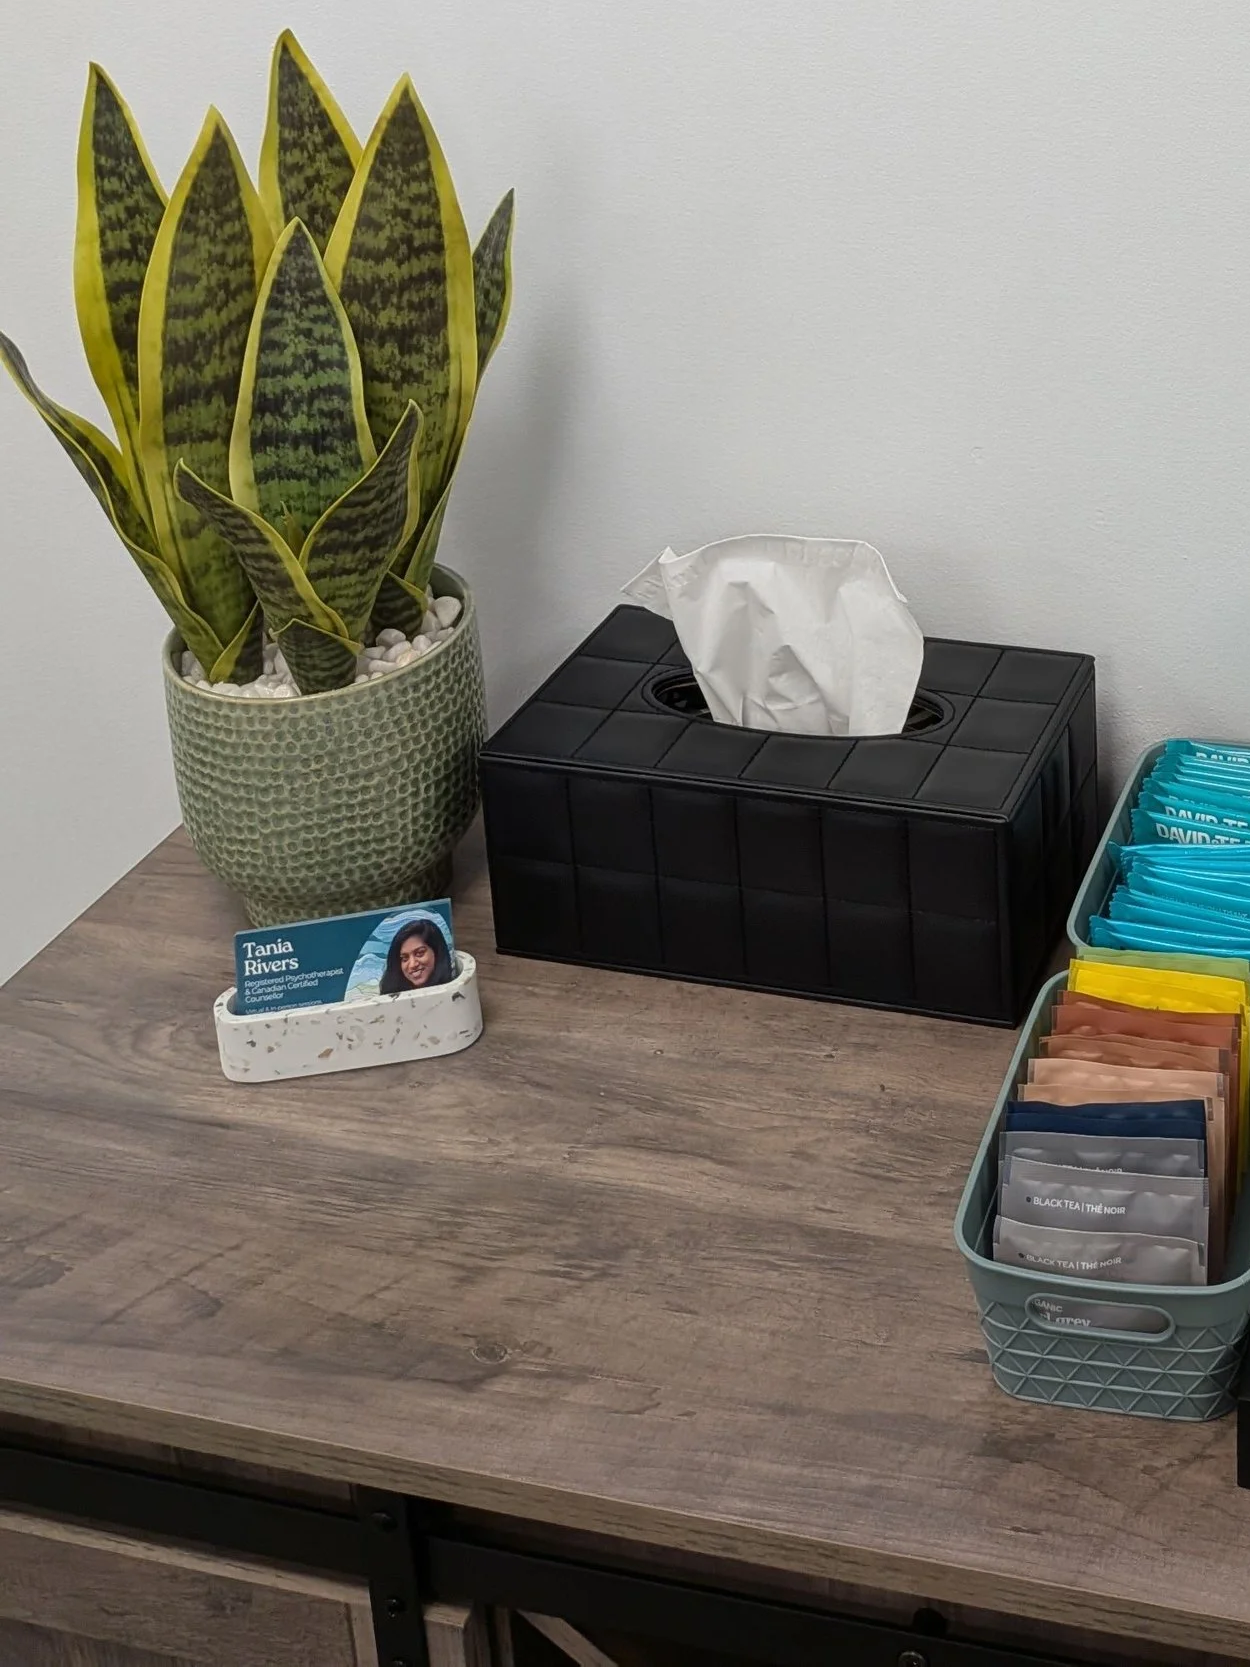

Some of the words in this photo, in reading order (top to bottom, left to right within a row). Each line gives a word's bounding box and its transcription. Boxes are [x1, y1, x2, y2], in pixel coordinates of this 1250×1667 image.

[243, 938, 293, 958] Tania
[244, 958, 299, 976] Rivers
[244, 977, 284, 988] Registered
[285, 968, 344, 982] Psychotherapist
[252, 985, 286, 995] Canadian
[1033, 1196, 1062, 1208] BLACK
[1064, 1200, 1080, 1210] TEA
[1086, 1202, 1103, 1214] THÉ
[1104, 1206, 1126, 1214] NOIR
[1026, 1254, 1055, 1266] BLACK
[1056, 1260, 1075, 1270] TEA
[1099, 1256, 1122, 1268] NOIR
